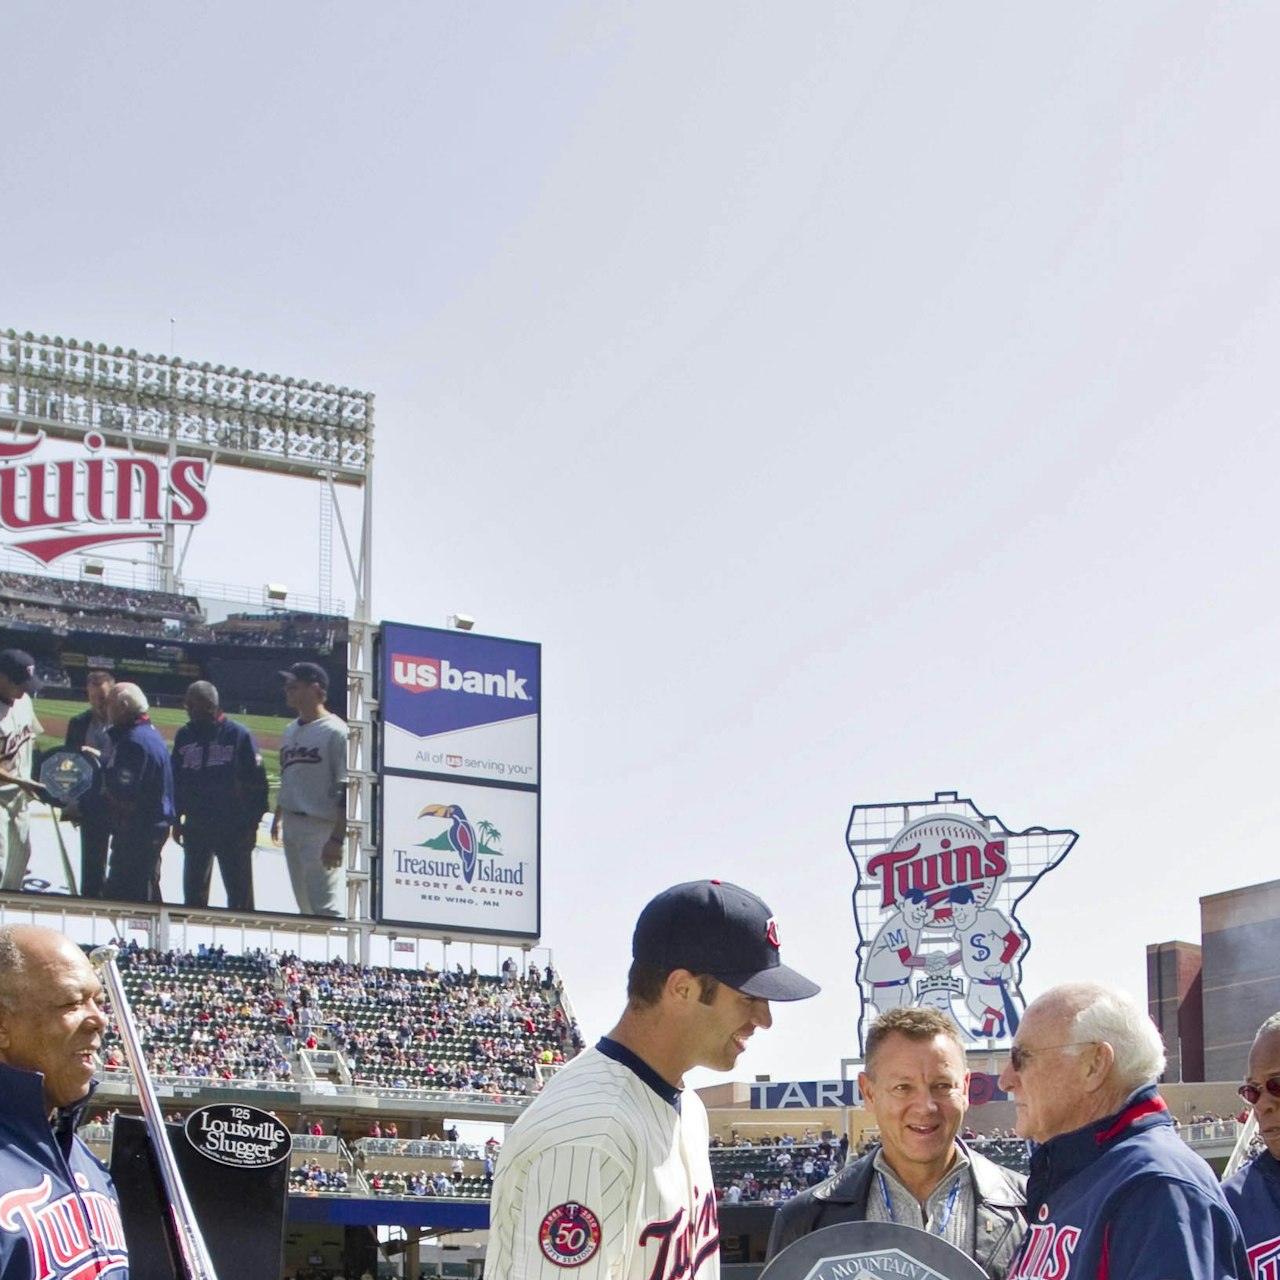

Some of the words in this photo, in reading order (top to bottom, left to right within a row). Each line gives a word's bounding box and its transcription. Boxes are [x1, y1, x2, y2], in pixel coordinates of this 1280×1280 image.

[415, 750, 431, 762] All
[432, 753, 443, 763] of
[464, 757, 505, 774] serving
[393, 849, 461, 879] Treasure
[477, 858, 524, 885] Island
[866, 838, 1007, 910] Twins
[395, 878, 449, 890] RESORT
[471, 886, 524, 897] CASINO
[420, 894, 441, 902] RED
[230, 1107, 251, 1120] 125
[200, 1111, 285, 1143] Louisville
[555, 1222, 586, 1250] 50
[832, 1256, 921, 1280] MOUNTAIN
